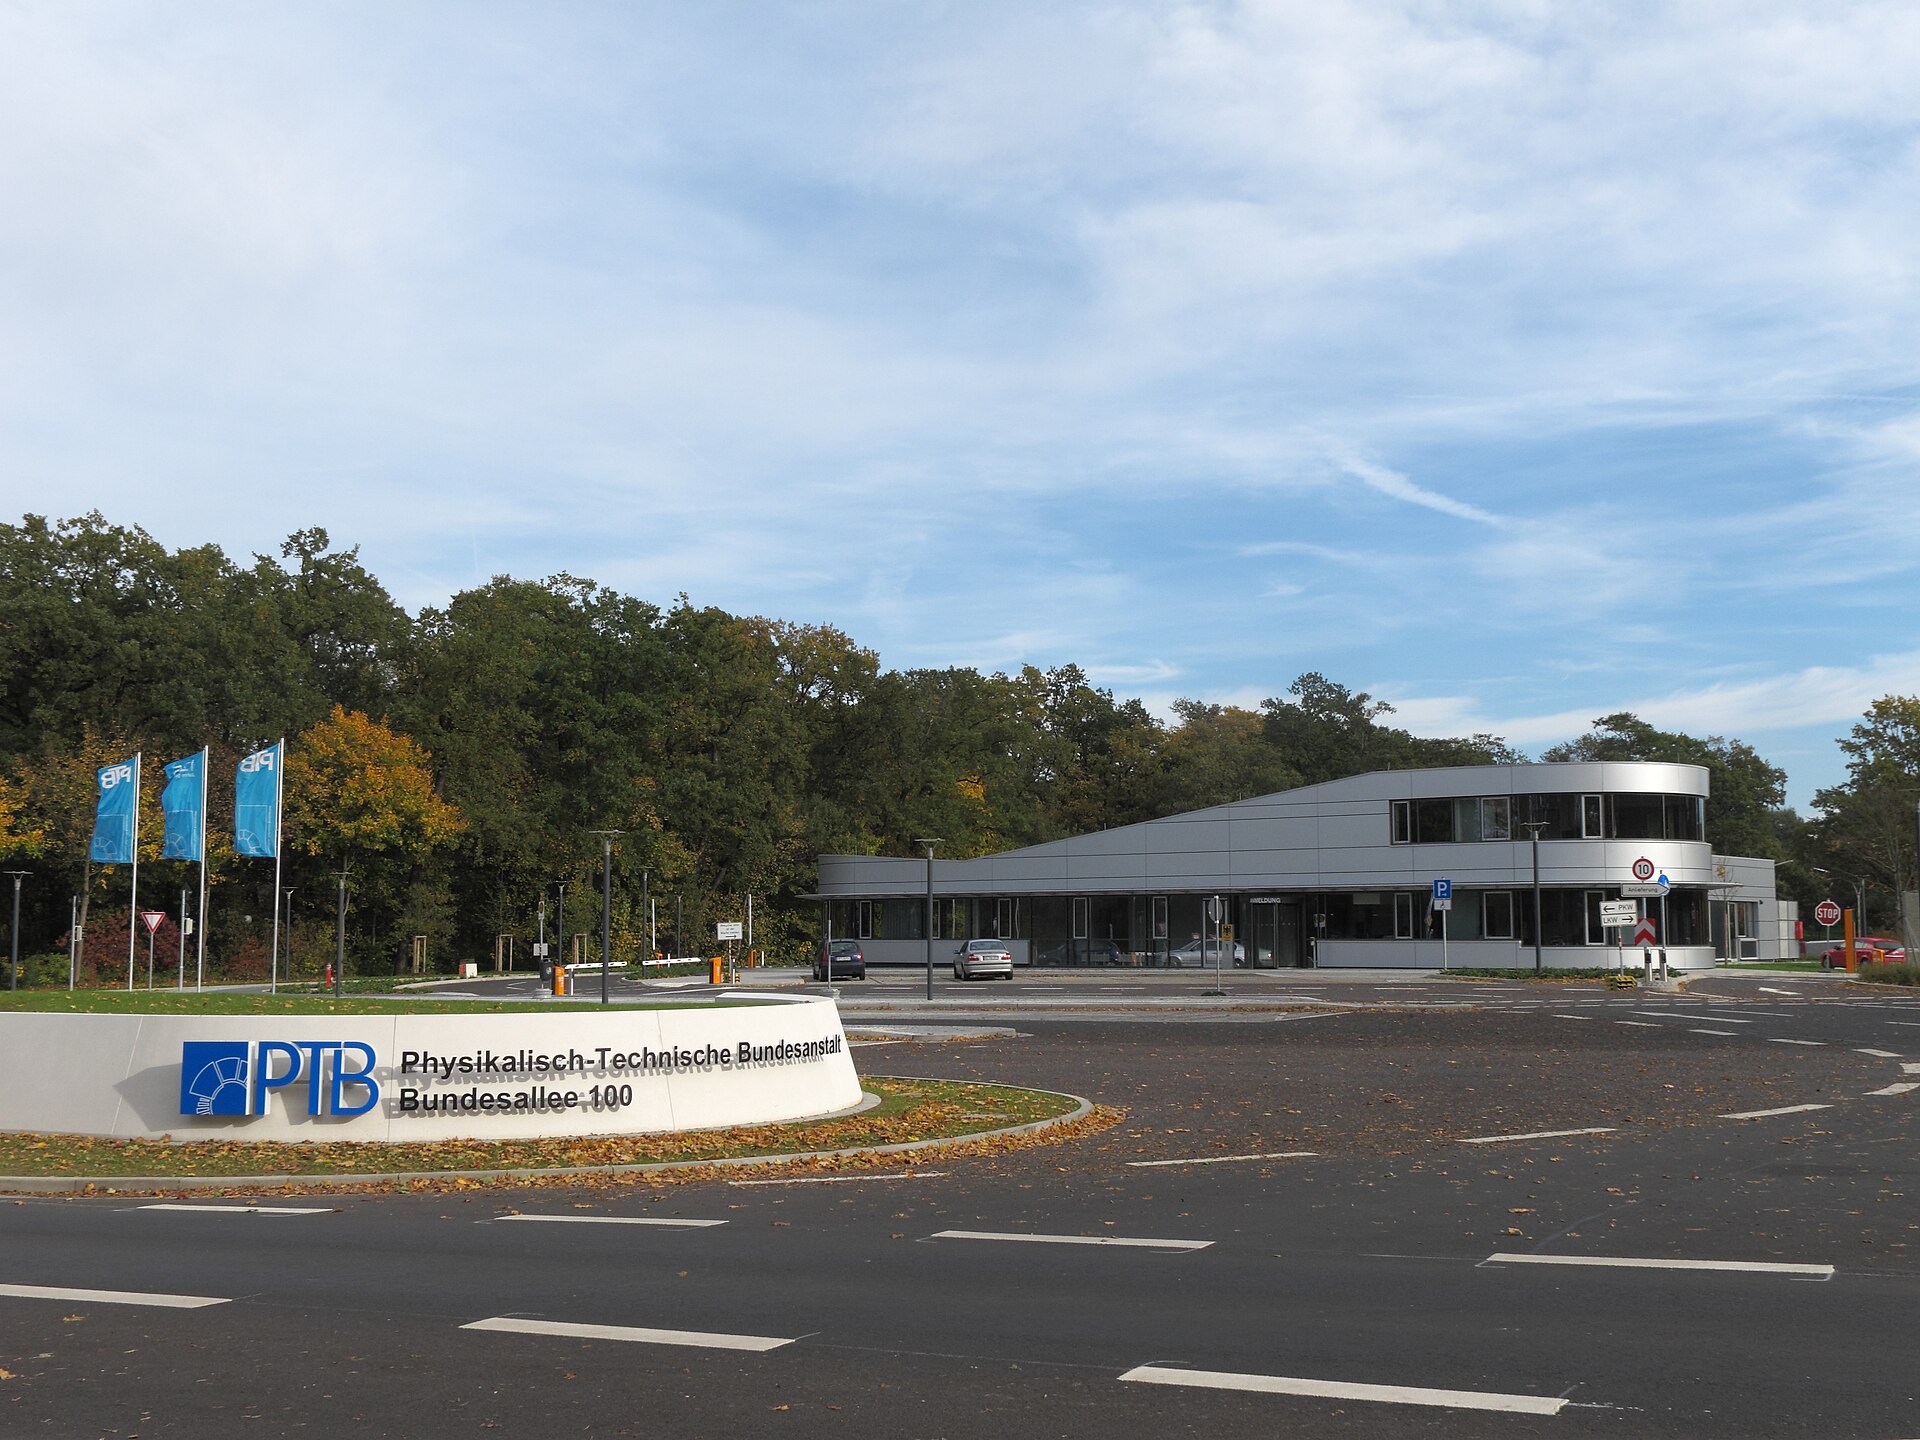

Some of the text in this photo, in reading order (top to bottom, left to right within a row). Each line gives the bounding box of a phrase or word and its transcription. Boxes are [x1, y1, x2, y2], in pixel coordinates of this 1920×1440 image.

[1638, 864, 1650, 875] 10
[1437, 881, 1448, 897] P
[1818, 908, 1838, 919] STOP
[401, 1034, 843, 1080] Physikalisch-Technische Bundesanstalt
[255, 1040, 381, 1116] PTB
[399, 1084, 634, 1112] Bundesallee 100
